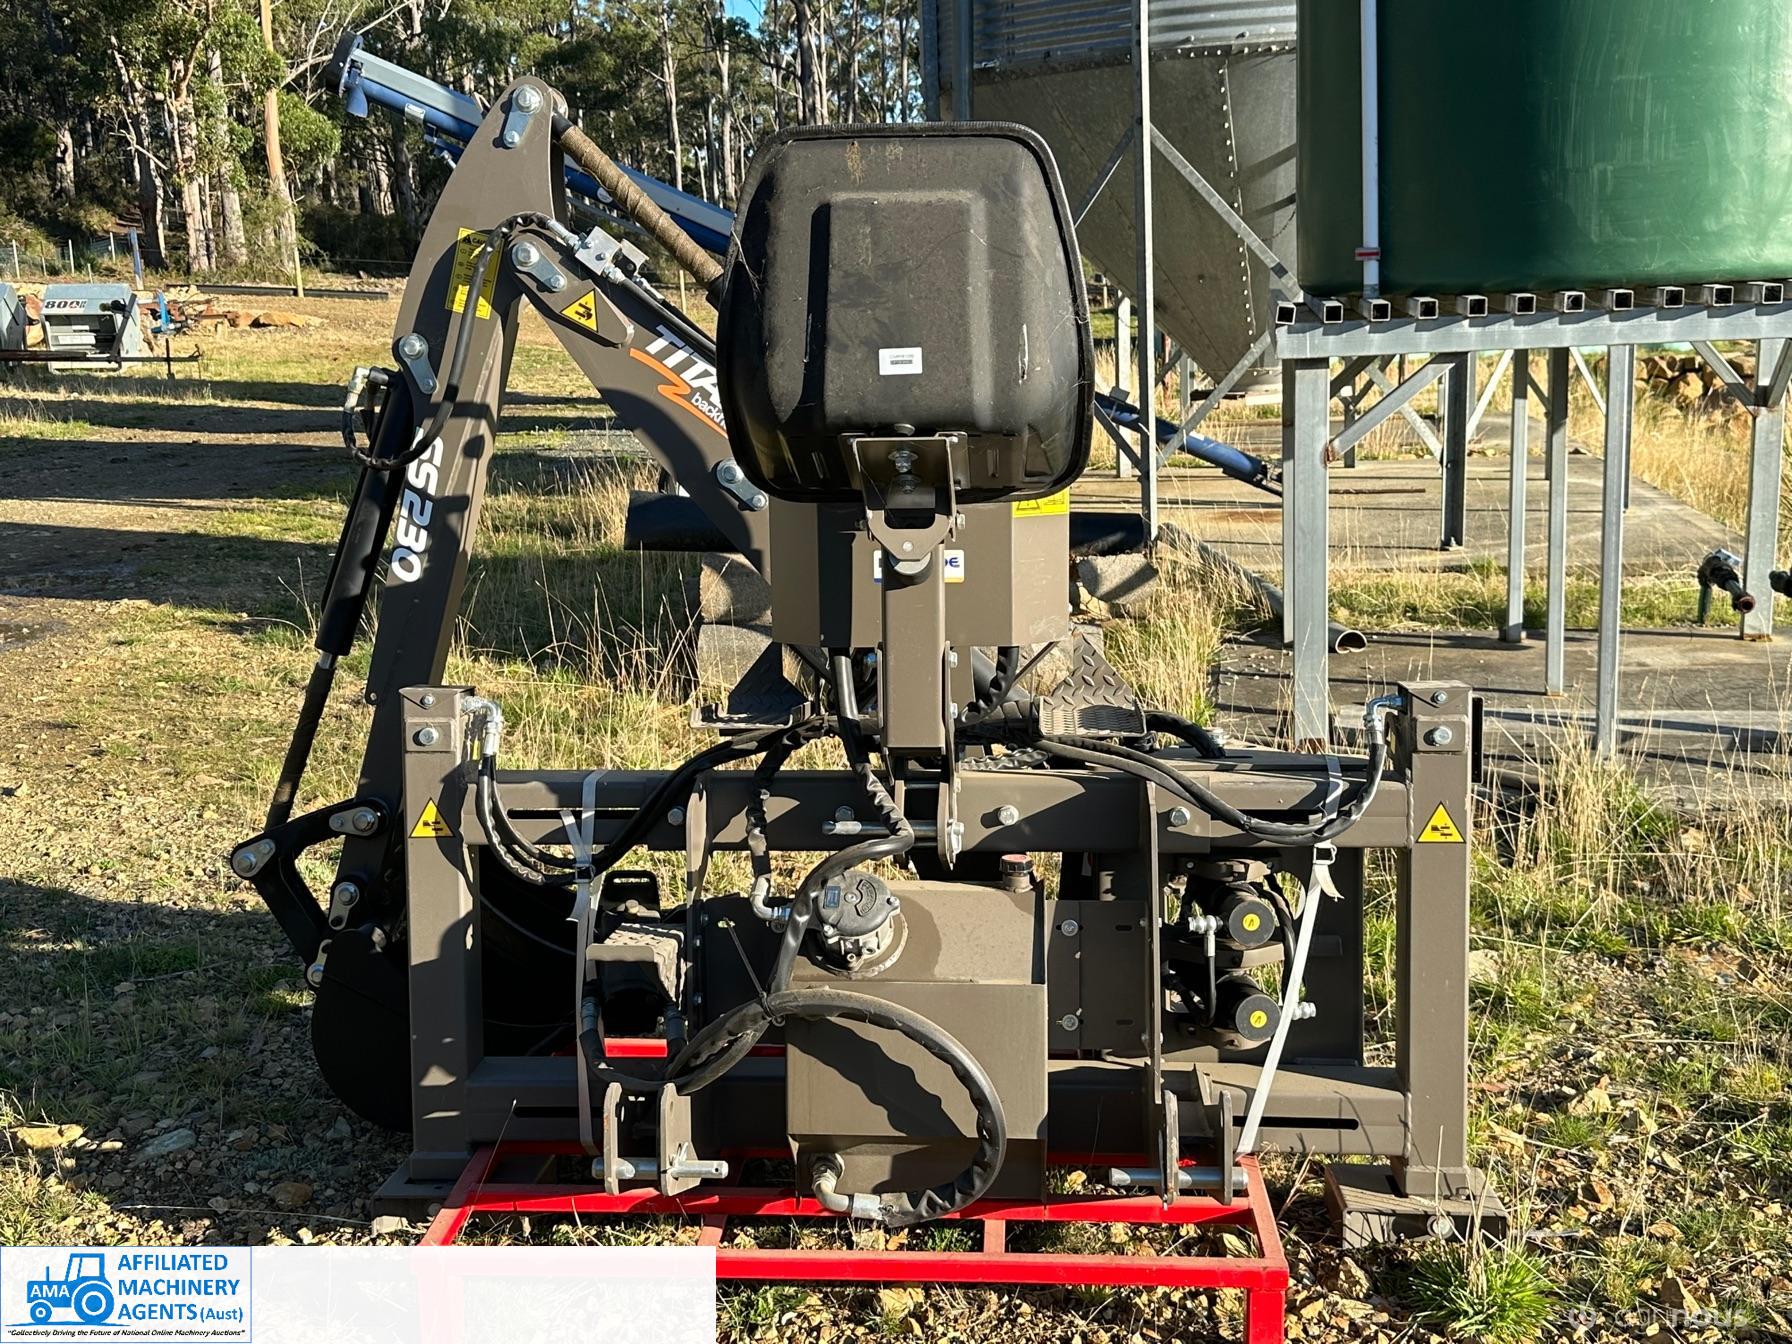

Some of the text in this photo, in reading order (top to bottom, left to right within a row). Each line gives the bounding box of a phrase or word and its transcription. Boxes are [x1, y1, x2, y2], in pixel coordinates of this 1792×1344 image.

[645, 325, 721, 409] TITA
[691, 392, 727, 431] backh
[391, 426, 444, 583] SS230
